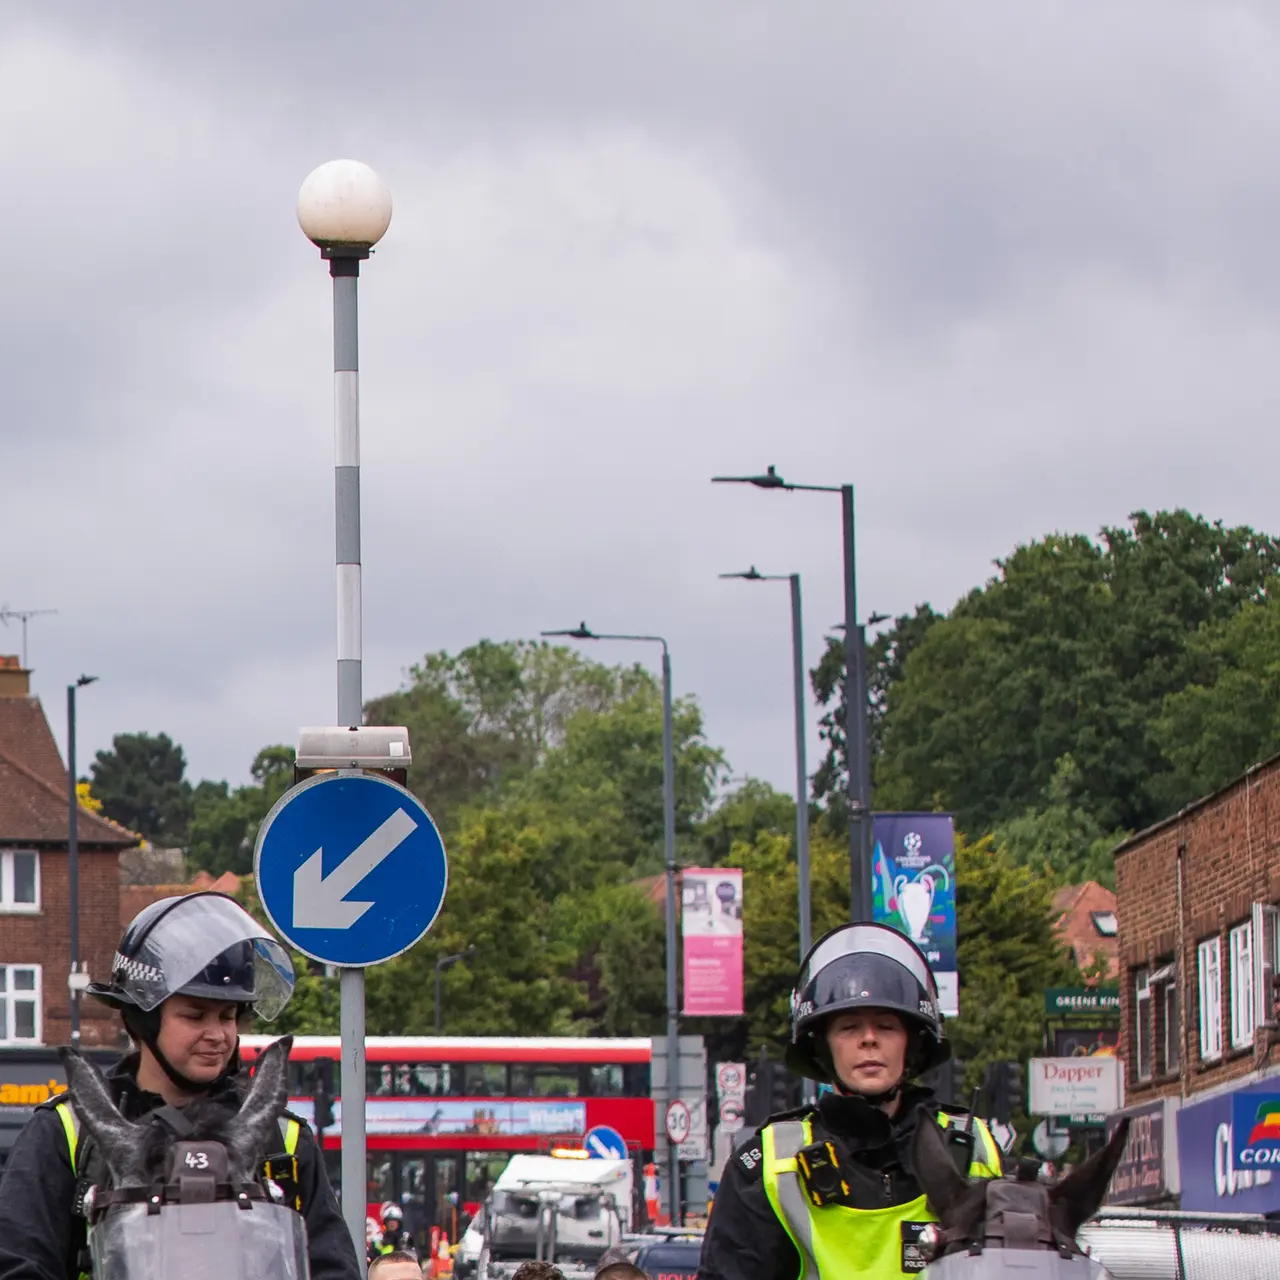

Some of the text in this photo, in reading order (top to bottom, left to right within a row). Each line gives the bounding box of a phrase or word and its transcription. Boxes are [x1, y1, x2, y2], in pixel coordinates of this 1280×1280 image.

[1056, 996, 1097, 1007] GREENE
[1043, 1063, 1104, 1081] Dapper
[669, 1112, 686, 1131] 30
[185, 1151, 209, 1169] 43
[904, 1260, 926, 1269] POLIC
